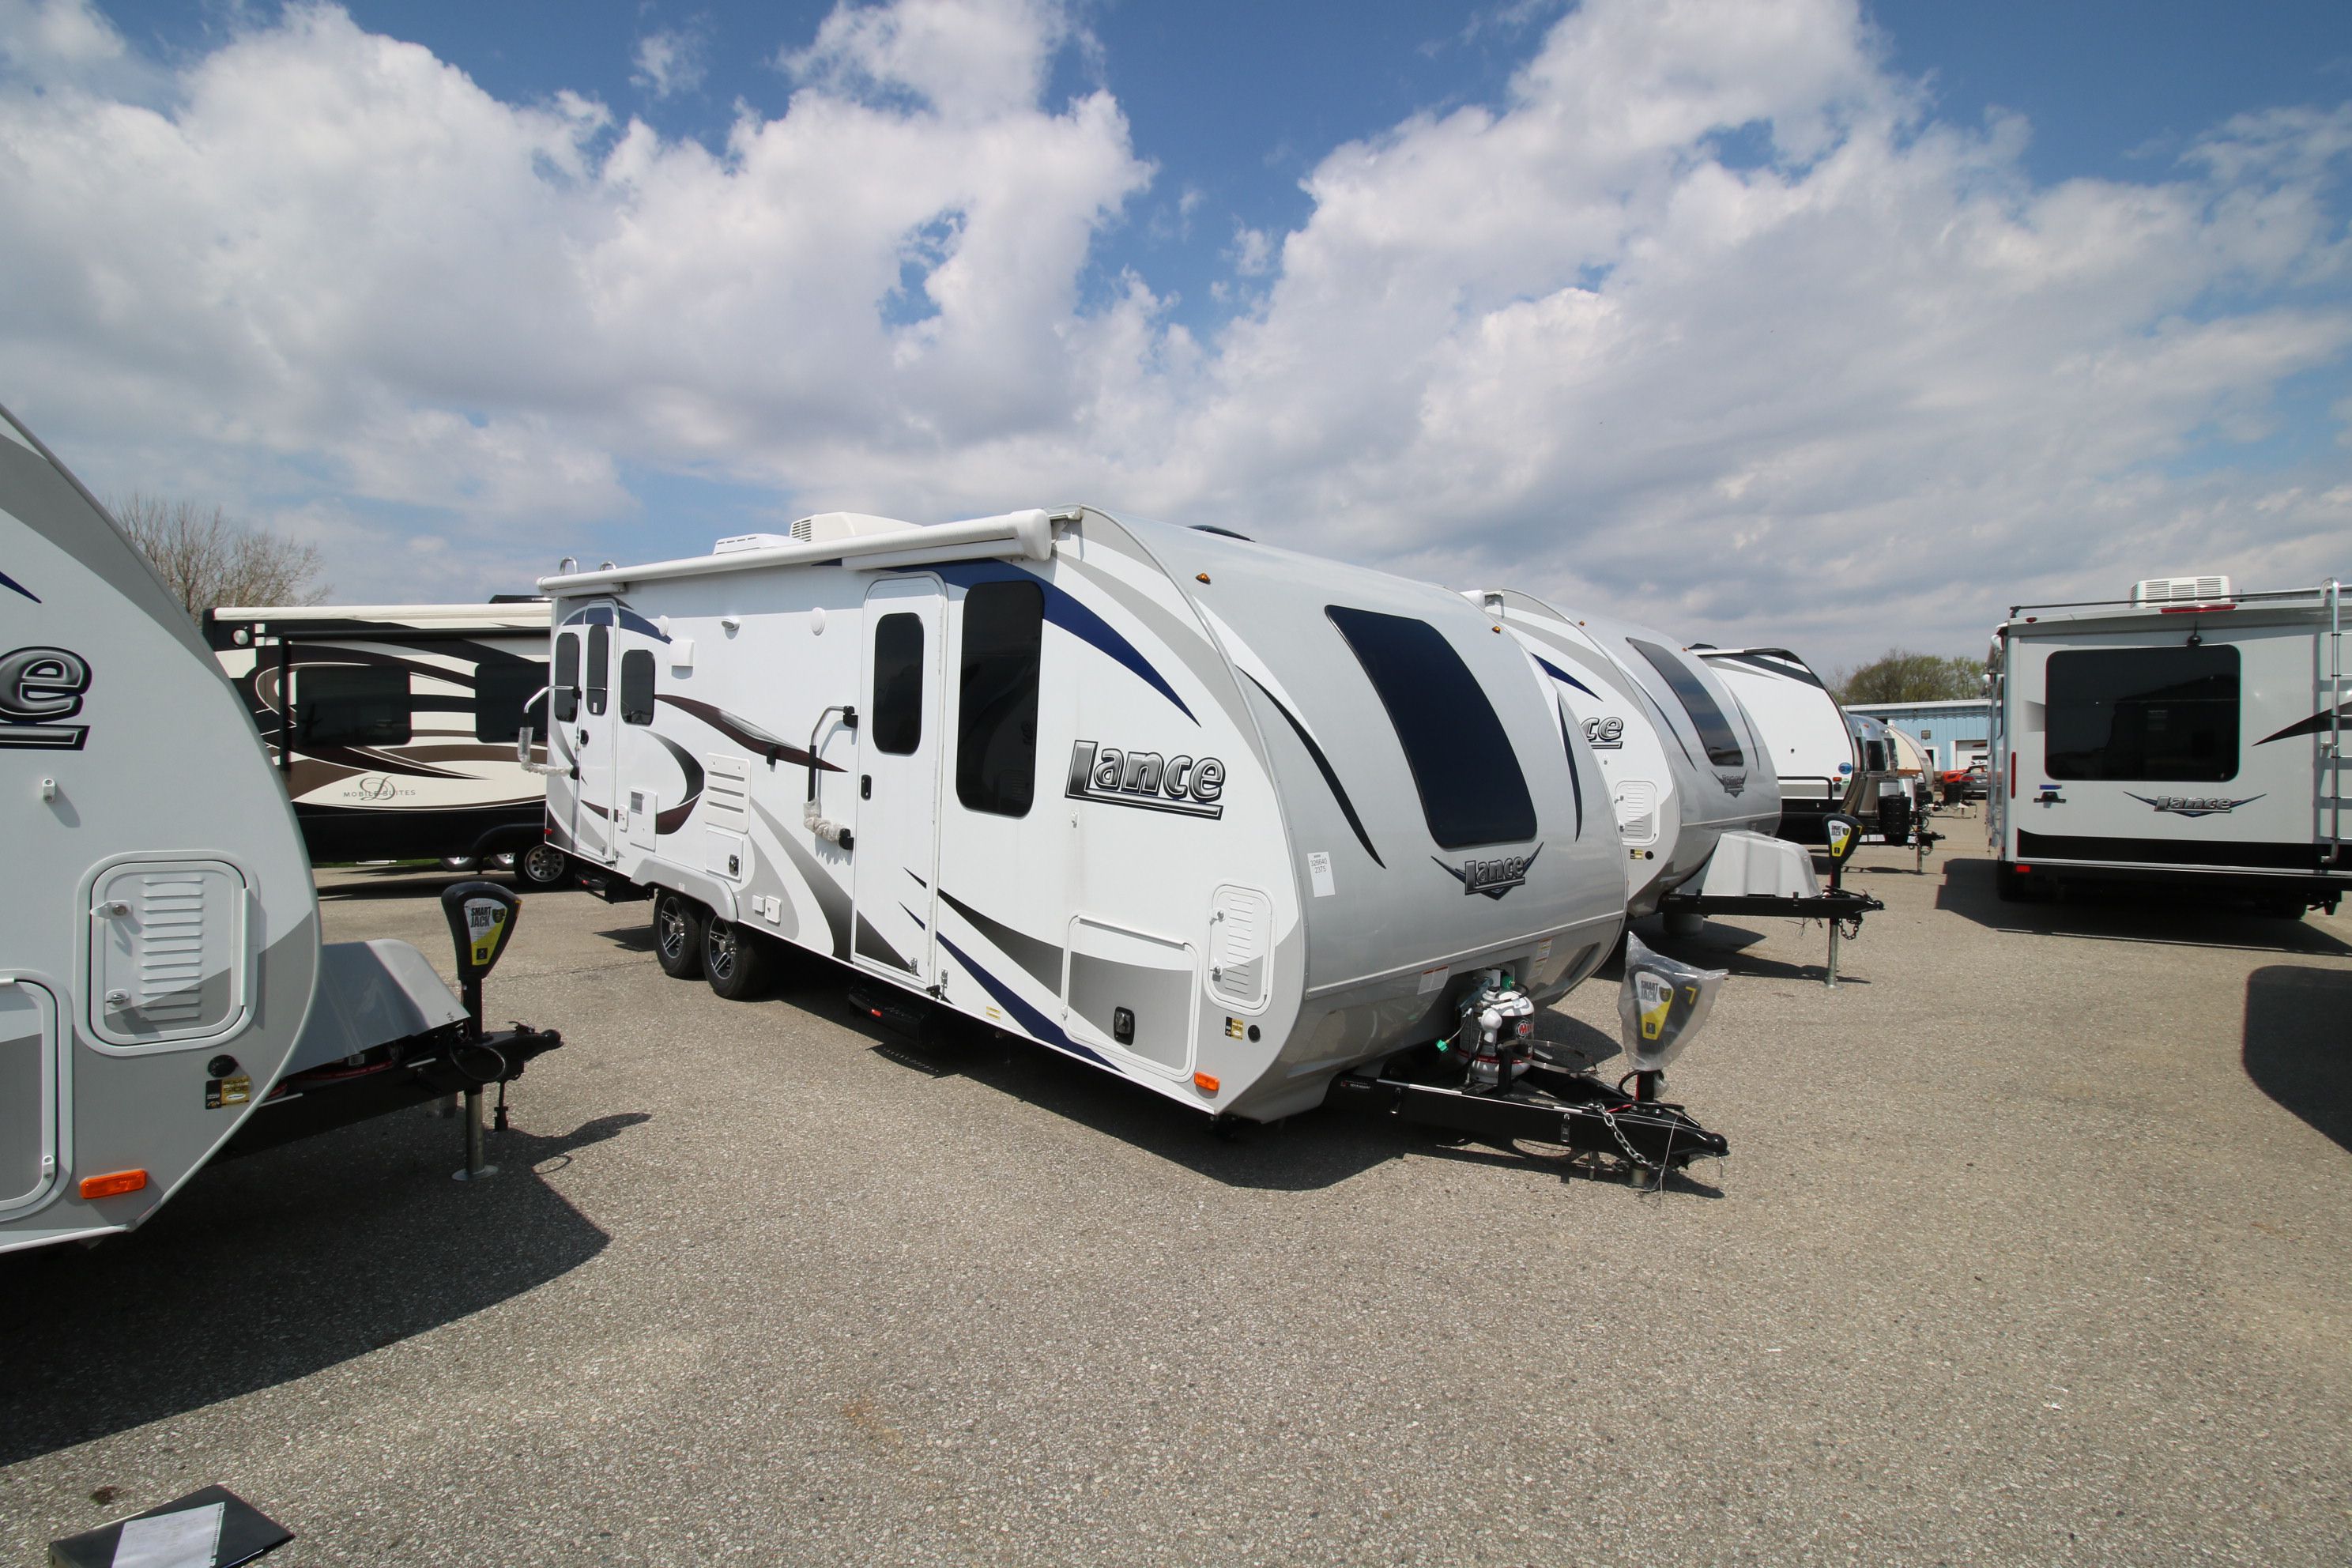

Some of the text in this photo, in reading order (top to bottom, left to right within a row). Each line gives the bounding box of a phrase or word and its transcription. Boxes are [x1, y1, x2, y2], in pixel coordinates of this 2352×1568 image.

[1065, 740, 1226, 820] Lance
[2154, 795, 2233, 814] Lance
[1464, 856, 1526, 895] Lance
[470, 906, 491, 916] SMART
[470, 915, 491, 928] JACK
[1641, 980, 1658, 990] SMART
[1641, 988, 1658, 1003] JACK
